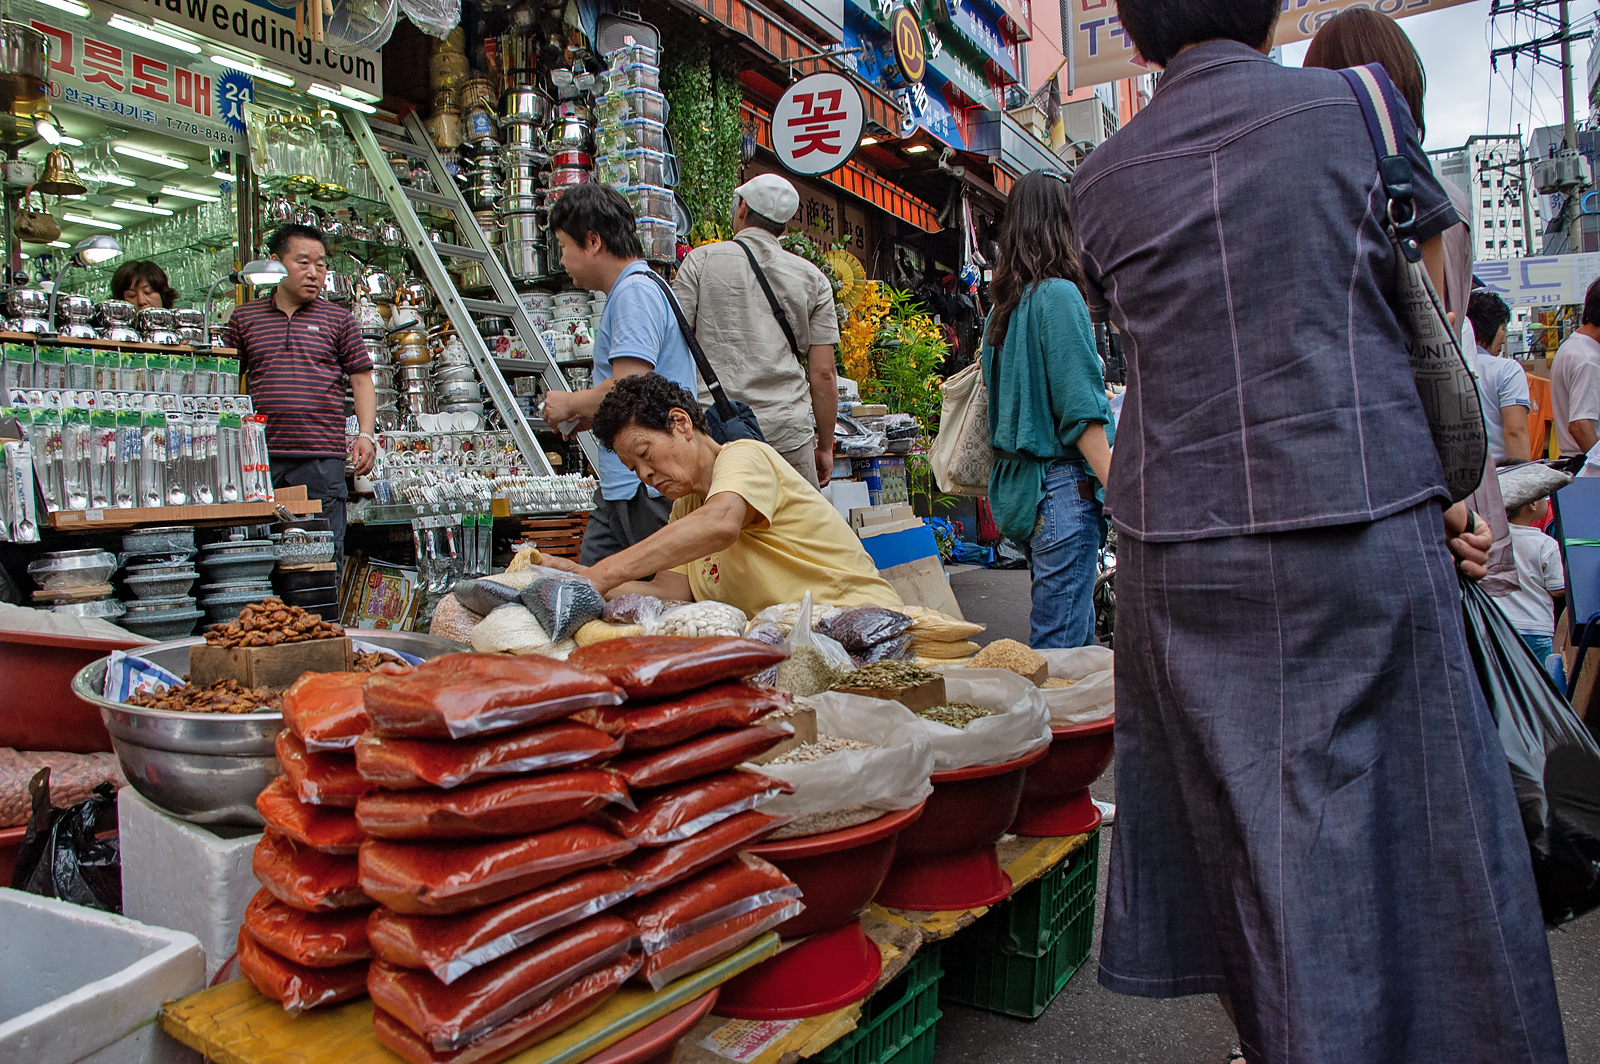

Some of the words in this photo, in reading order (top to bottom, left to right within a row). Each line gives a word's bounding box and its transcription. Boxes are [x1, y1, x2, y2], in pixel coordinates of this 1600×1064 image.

[30, 19, 212, 118] 그릇도매
[65, 87, 158, 125] 한국도자기(주)
[225, 82, 250, 103] 24
[165, 116, 235, 145] T.778-8484
[788, 88, 847, 159] 꽃
